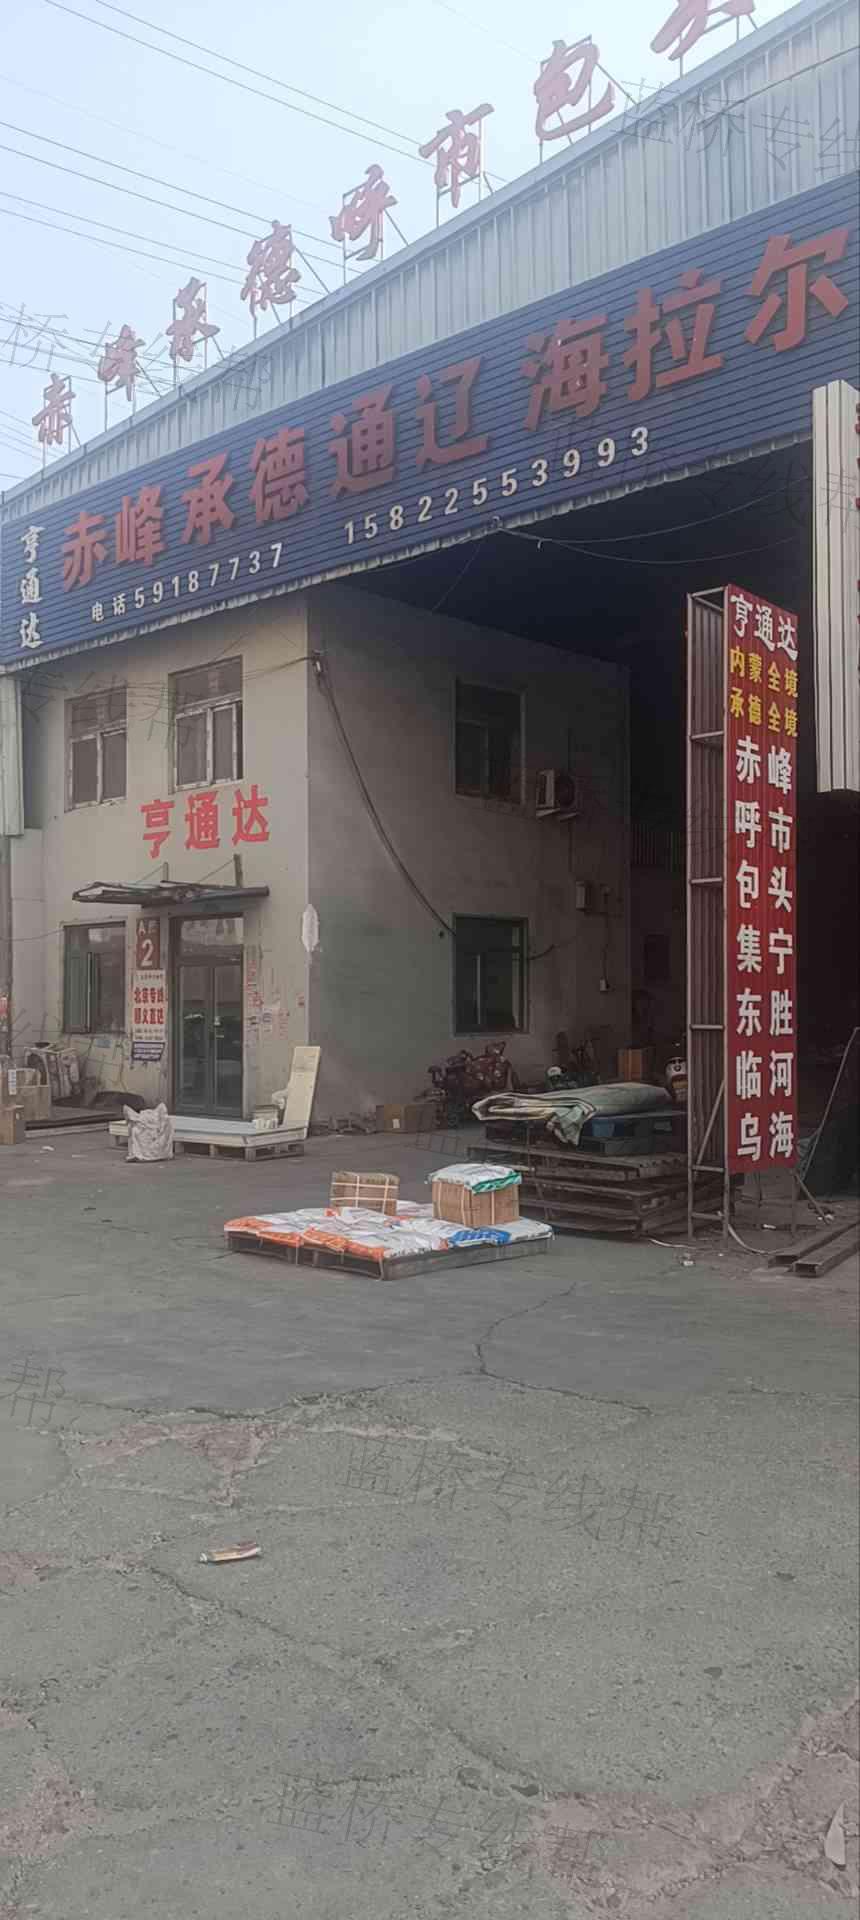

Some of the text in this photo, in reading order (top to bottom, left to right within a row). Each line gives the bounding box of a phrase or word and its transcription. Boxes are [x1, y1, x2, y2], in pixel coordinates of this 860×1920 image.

[344, 426, 649, 546] 15822553993
[19, 524, 45, 650] 亨通达
[729, 592, 798, 662] 亨通达
[140, 784, 270, 860] 亨通达
[140, 938, 154, 967] 2
